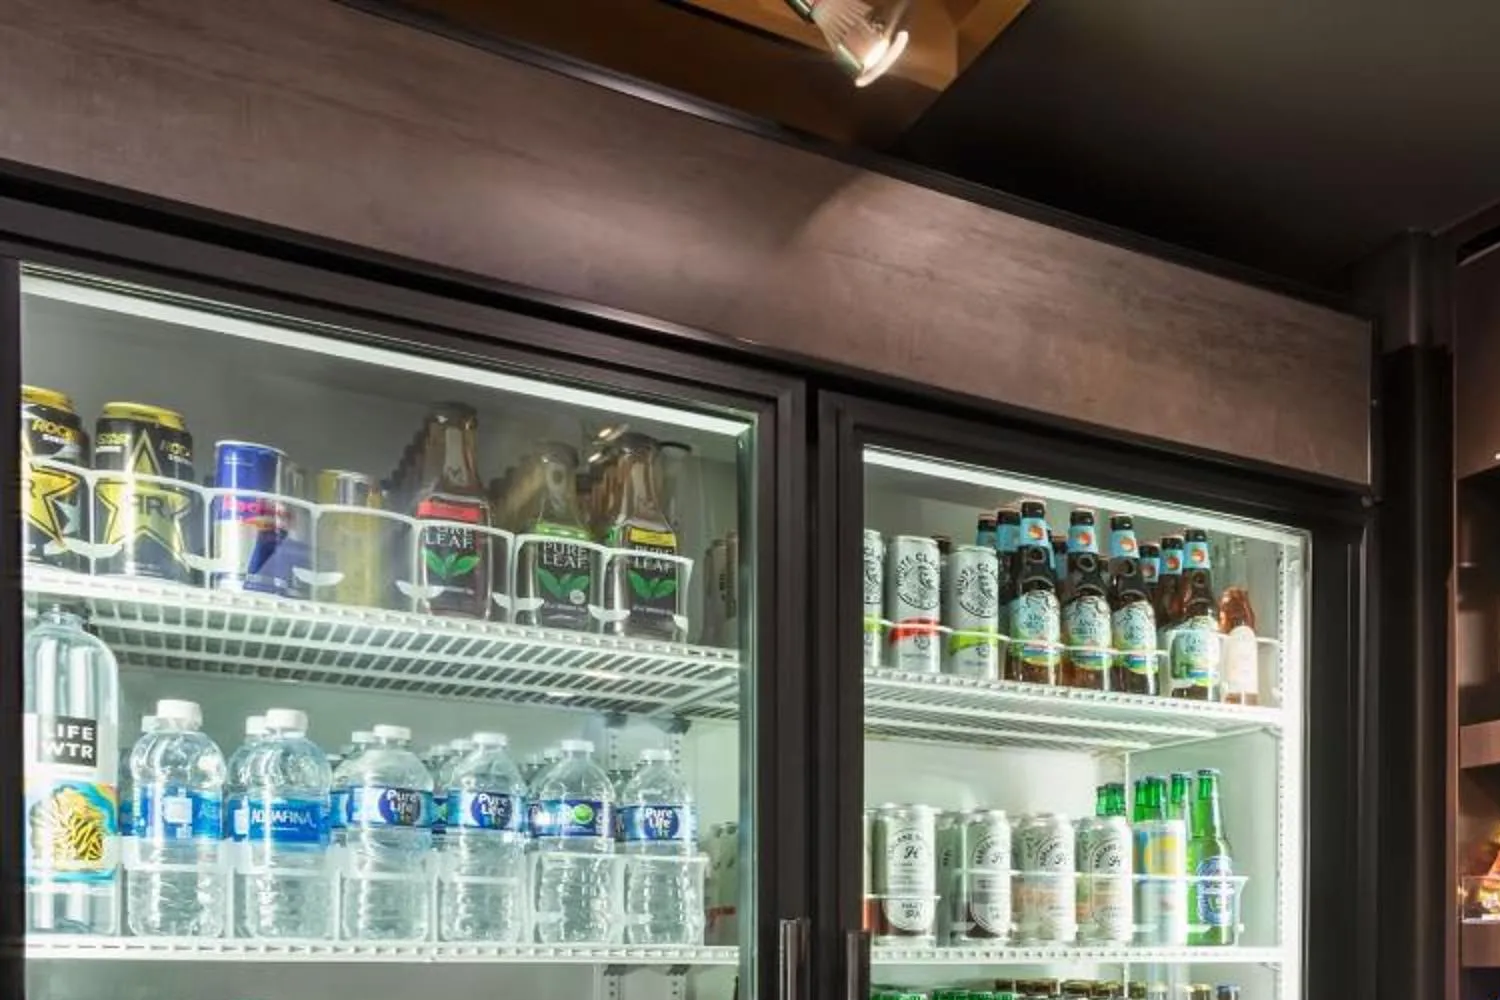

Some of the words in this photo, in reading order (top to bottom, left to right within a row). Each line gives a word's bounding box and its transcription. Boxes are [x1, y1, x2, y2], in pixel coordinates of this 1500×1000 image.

[543, 553, 589, 570] LEAF
[386, 788, 419, 803] Pure
[477, 792, 508, 806] Pure
[251, 809, 314, 826] AQAFINA
[645, 806, 674, 820] Pure
